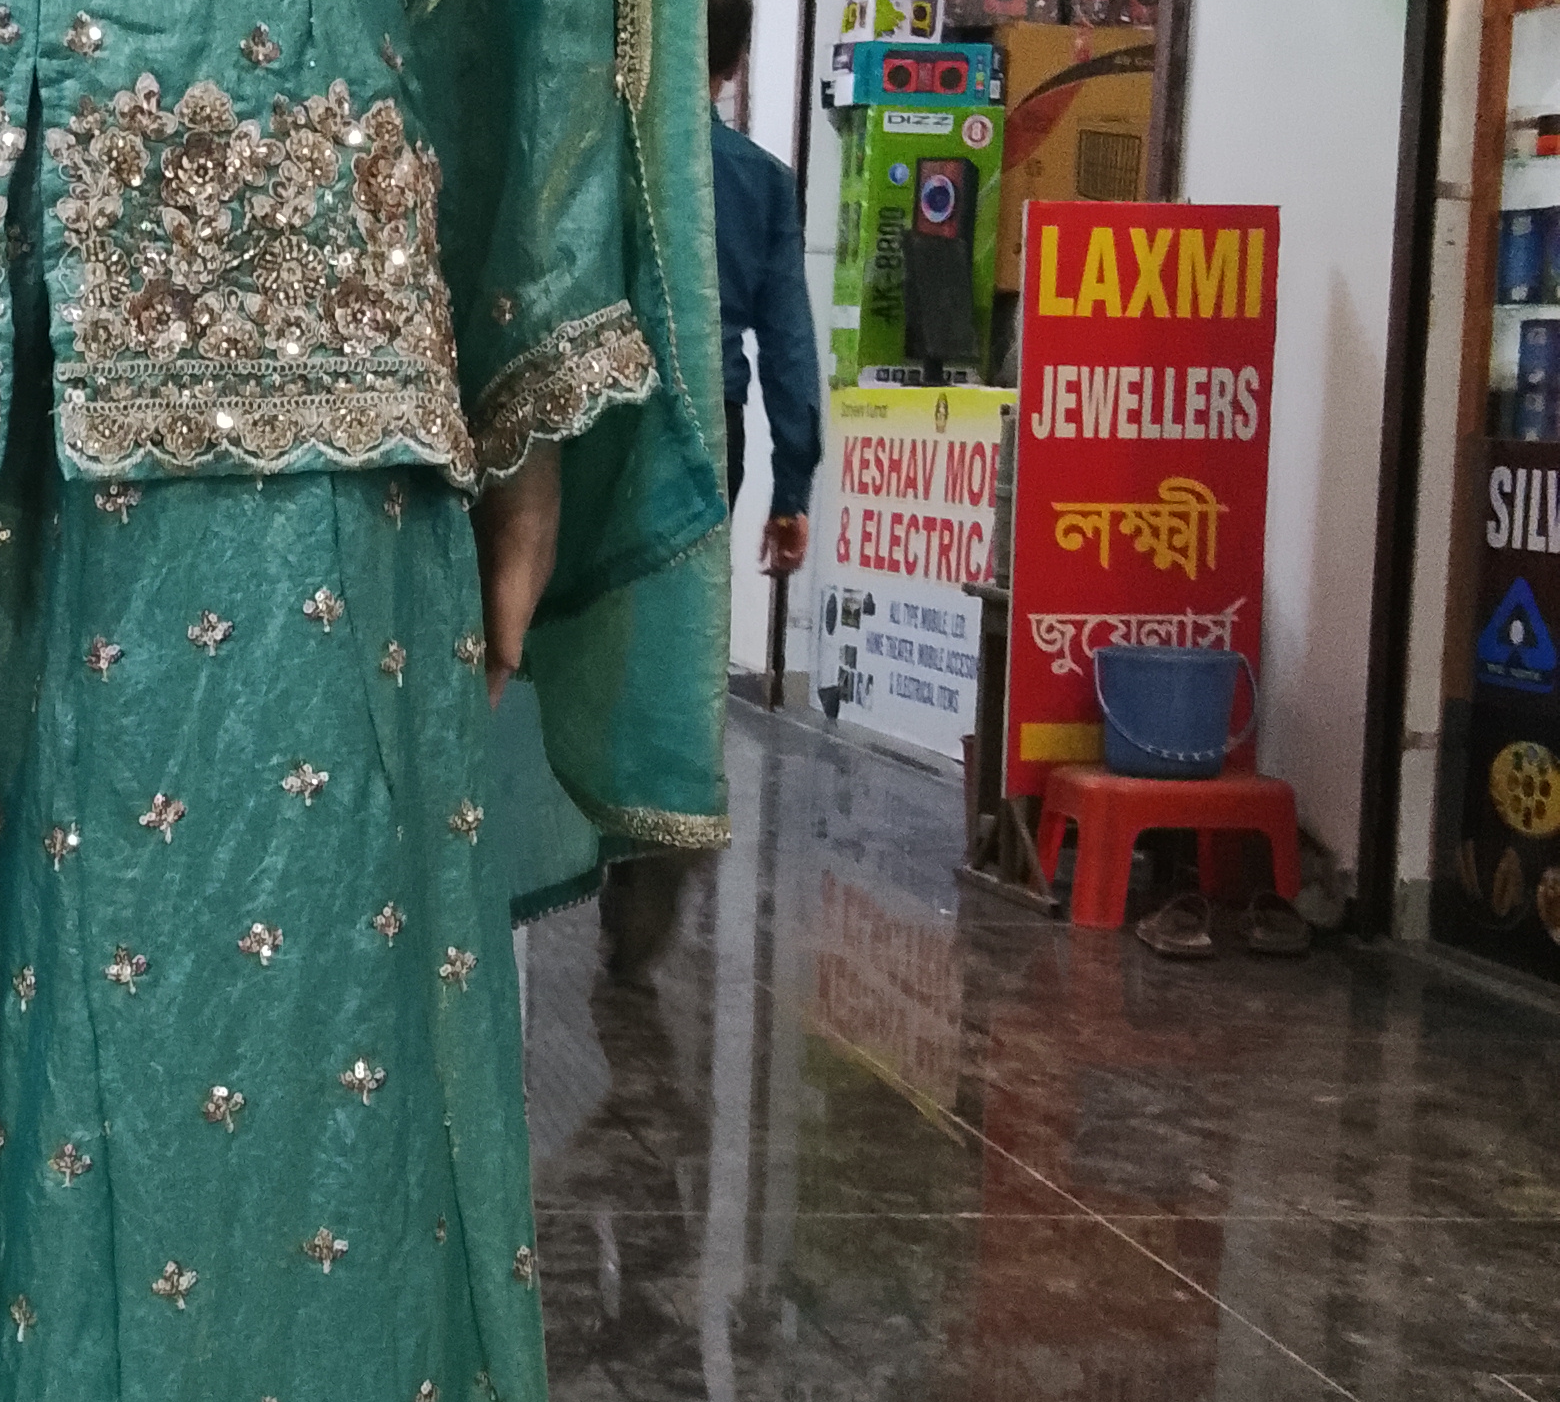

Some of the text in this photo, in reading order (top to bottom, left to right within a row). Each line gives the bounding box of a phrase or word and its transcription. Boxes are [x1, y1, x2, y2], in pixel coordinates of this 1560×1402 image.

[1038, 224, 1266, 319] LAXMI
[1030, 364, 1260, 441] JEWELLERS
[842, 435, 939, 501] KESHAV
[836, 505, 851, 563] &
[1051, 477, 1230, 580] লক্ষ্মী
